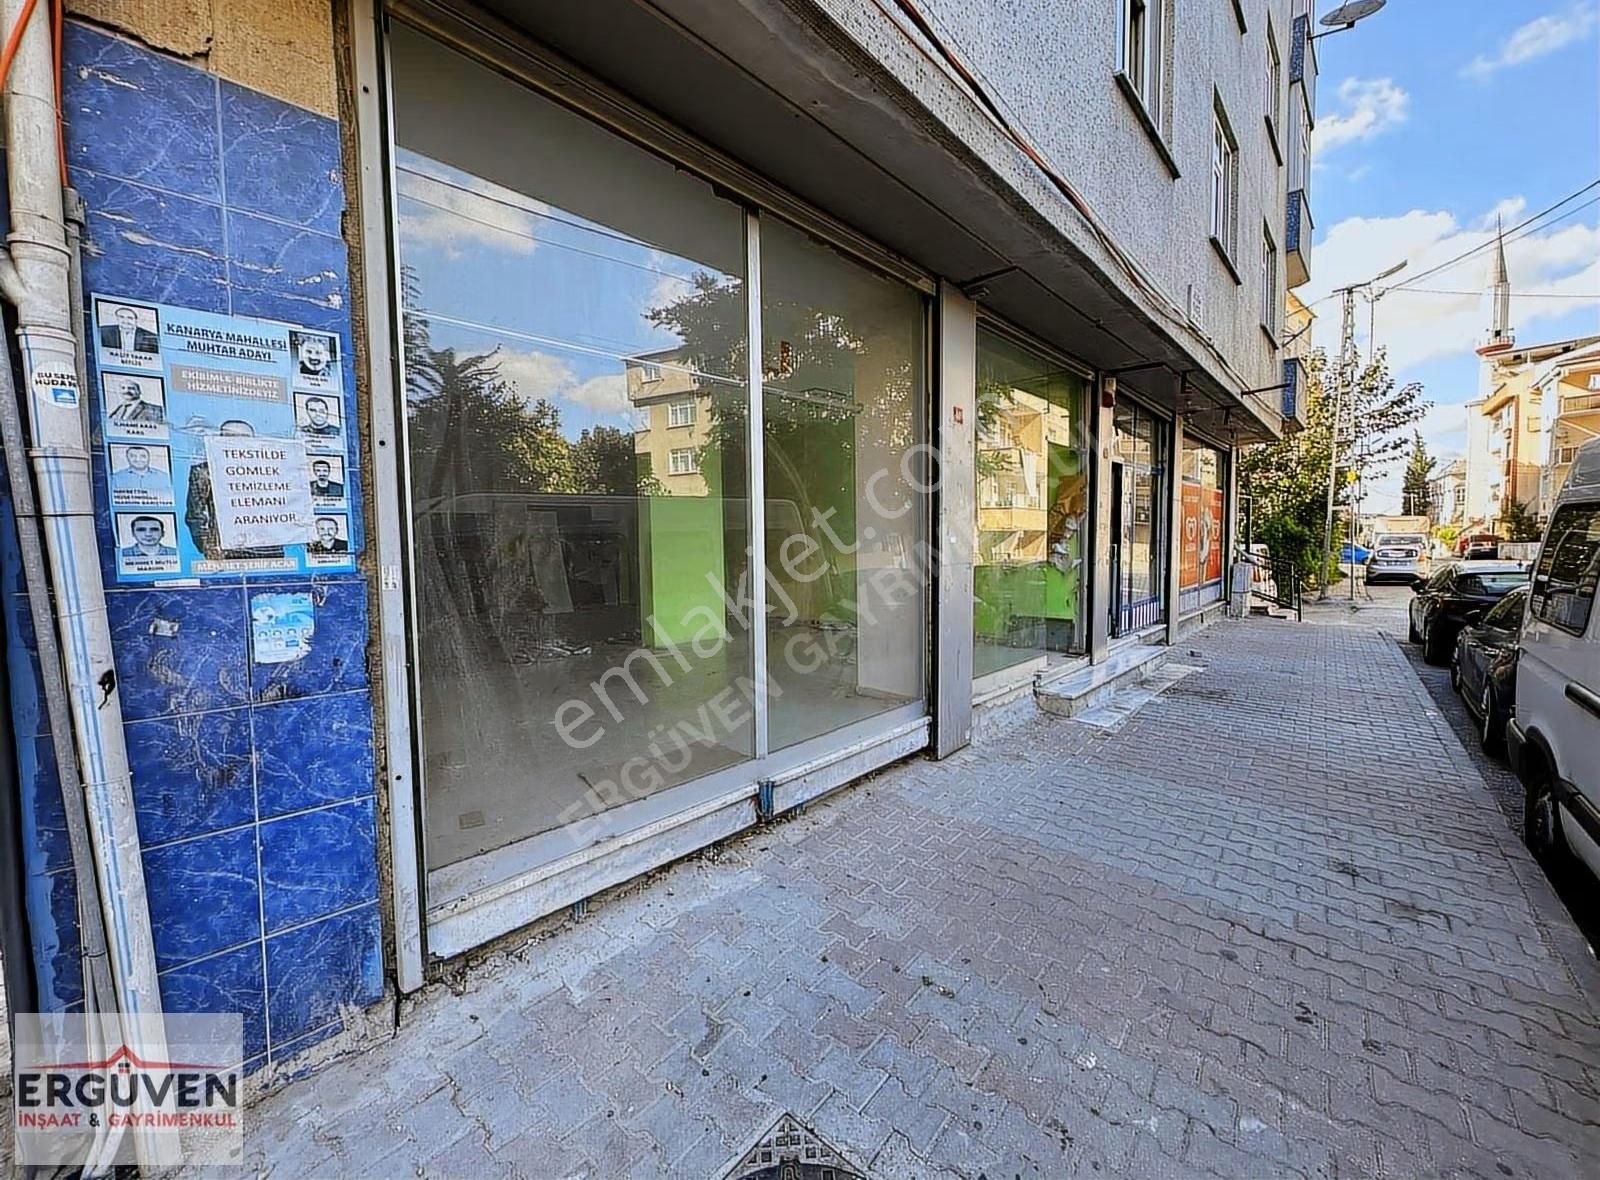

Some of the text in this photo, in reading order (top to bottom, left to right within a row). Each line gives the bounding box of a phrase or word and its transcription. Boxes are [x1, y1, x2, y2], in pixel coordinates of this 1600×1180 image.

[166, 323, 288, 350] KANARYA MAHALLESİ
[186, 340, 272, 361] MUHTAR ADAYI
[223, 447, 288, 461] TEKSTİLDE
[228, 480, 292, 492] TEMİZLEME
[231, 496, 287, 508] ELEMANI
[234, 511, 298, 525] ARANIYOR
